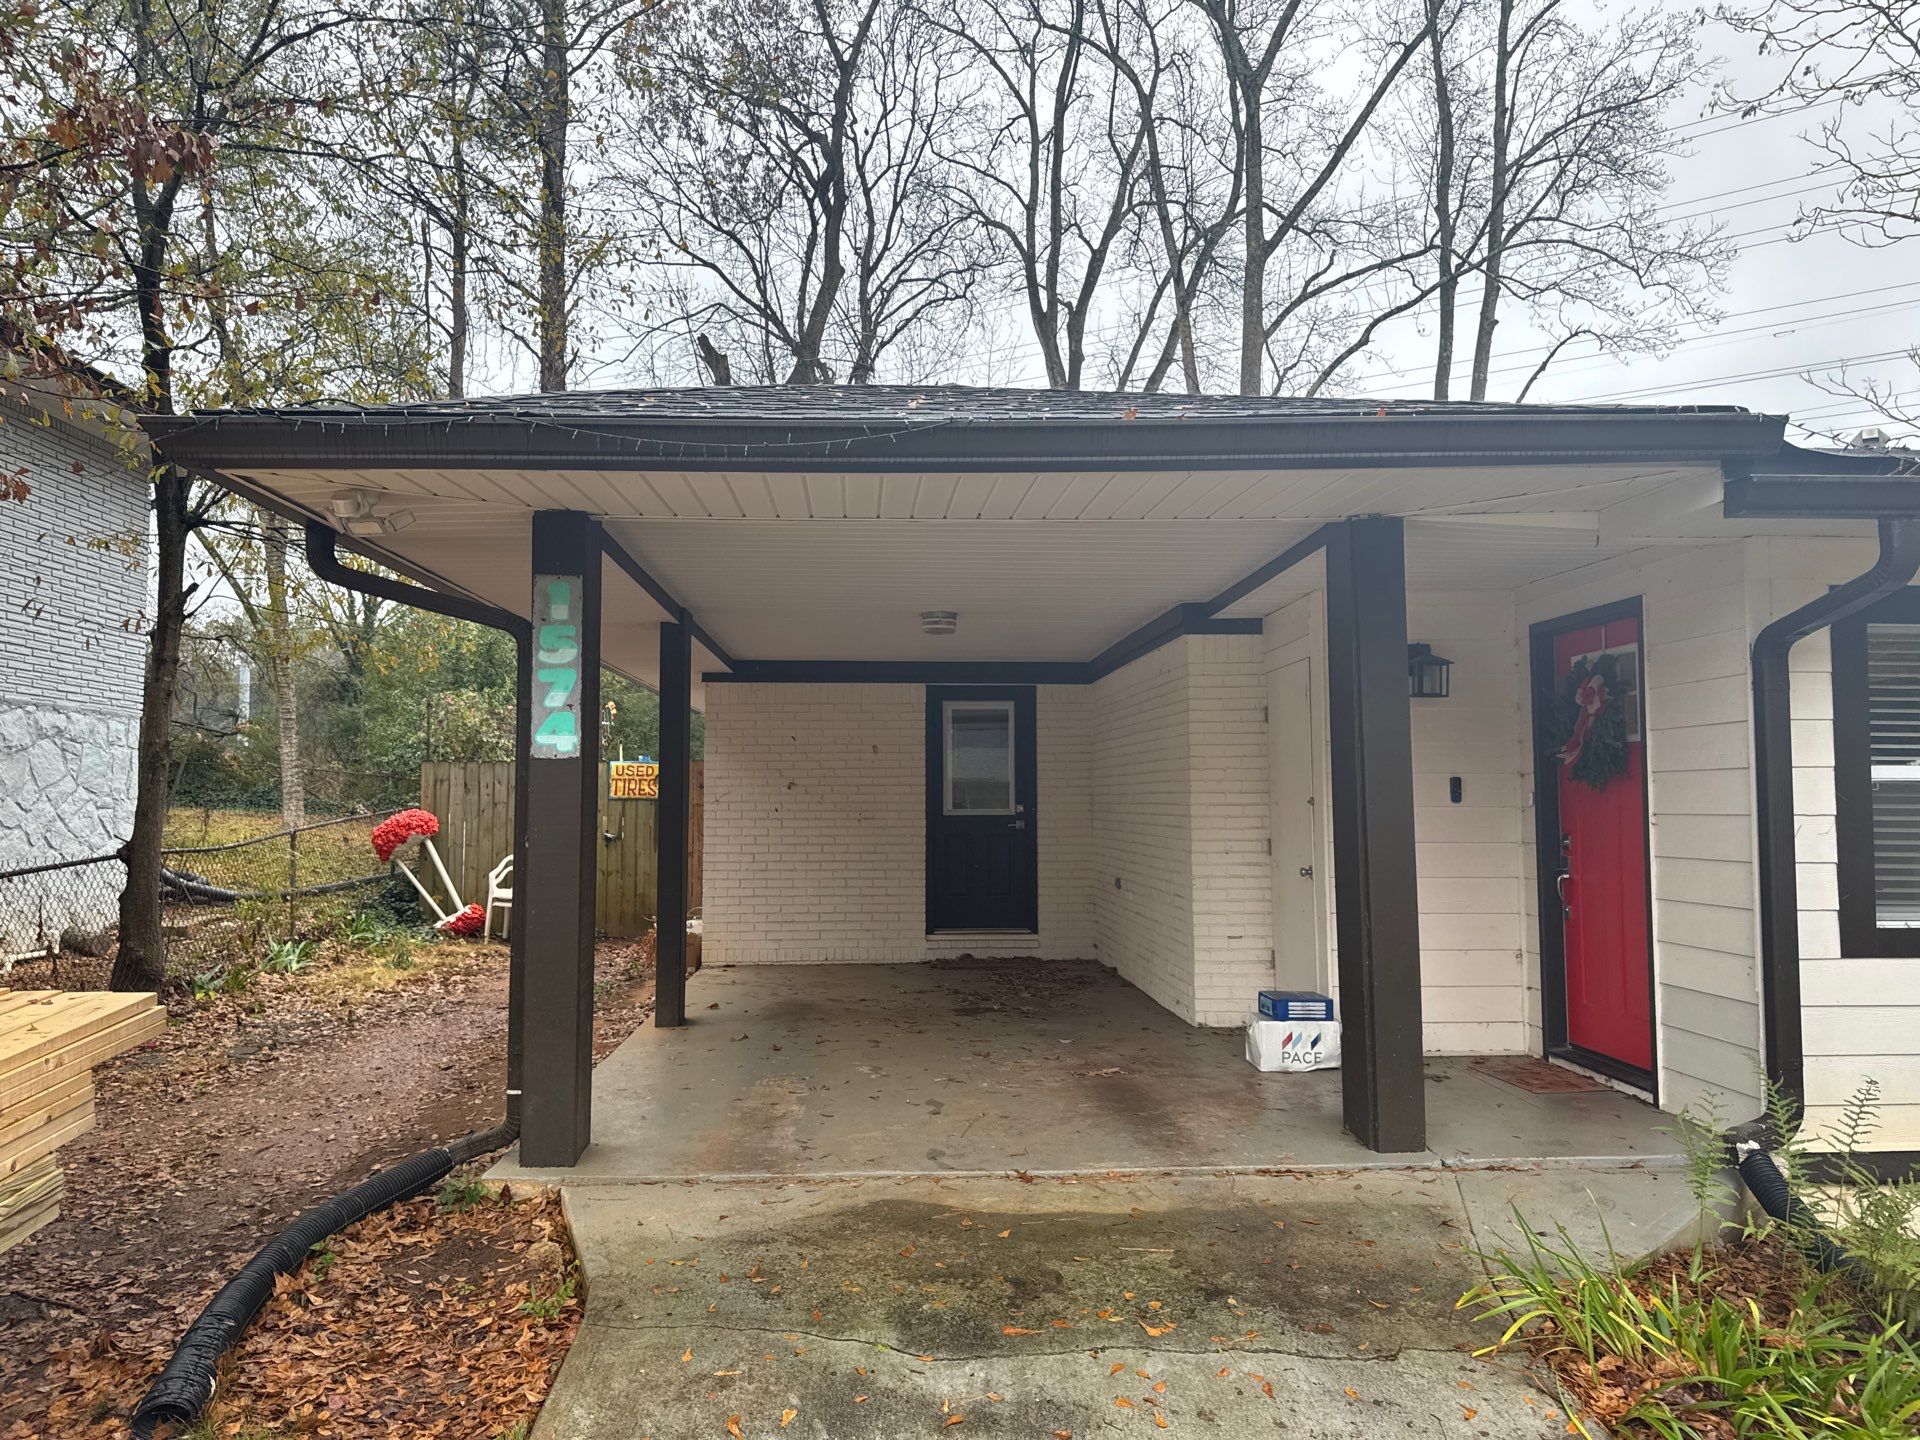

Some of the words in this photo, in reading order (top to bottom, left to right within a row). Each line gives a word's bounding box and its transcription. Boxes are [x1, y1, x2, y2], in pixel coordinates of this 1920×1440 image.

[535, 581, 578, 752] 1574
[615, 765, 655, 777] USED
[612, 778, 657, 797] TIRES
[1281, 1051, 1323, 1064] PACE
